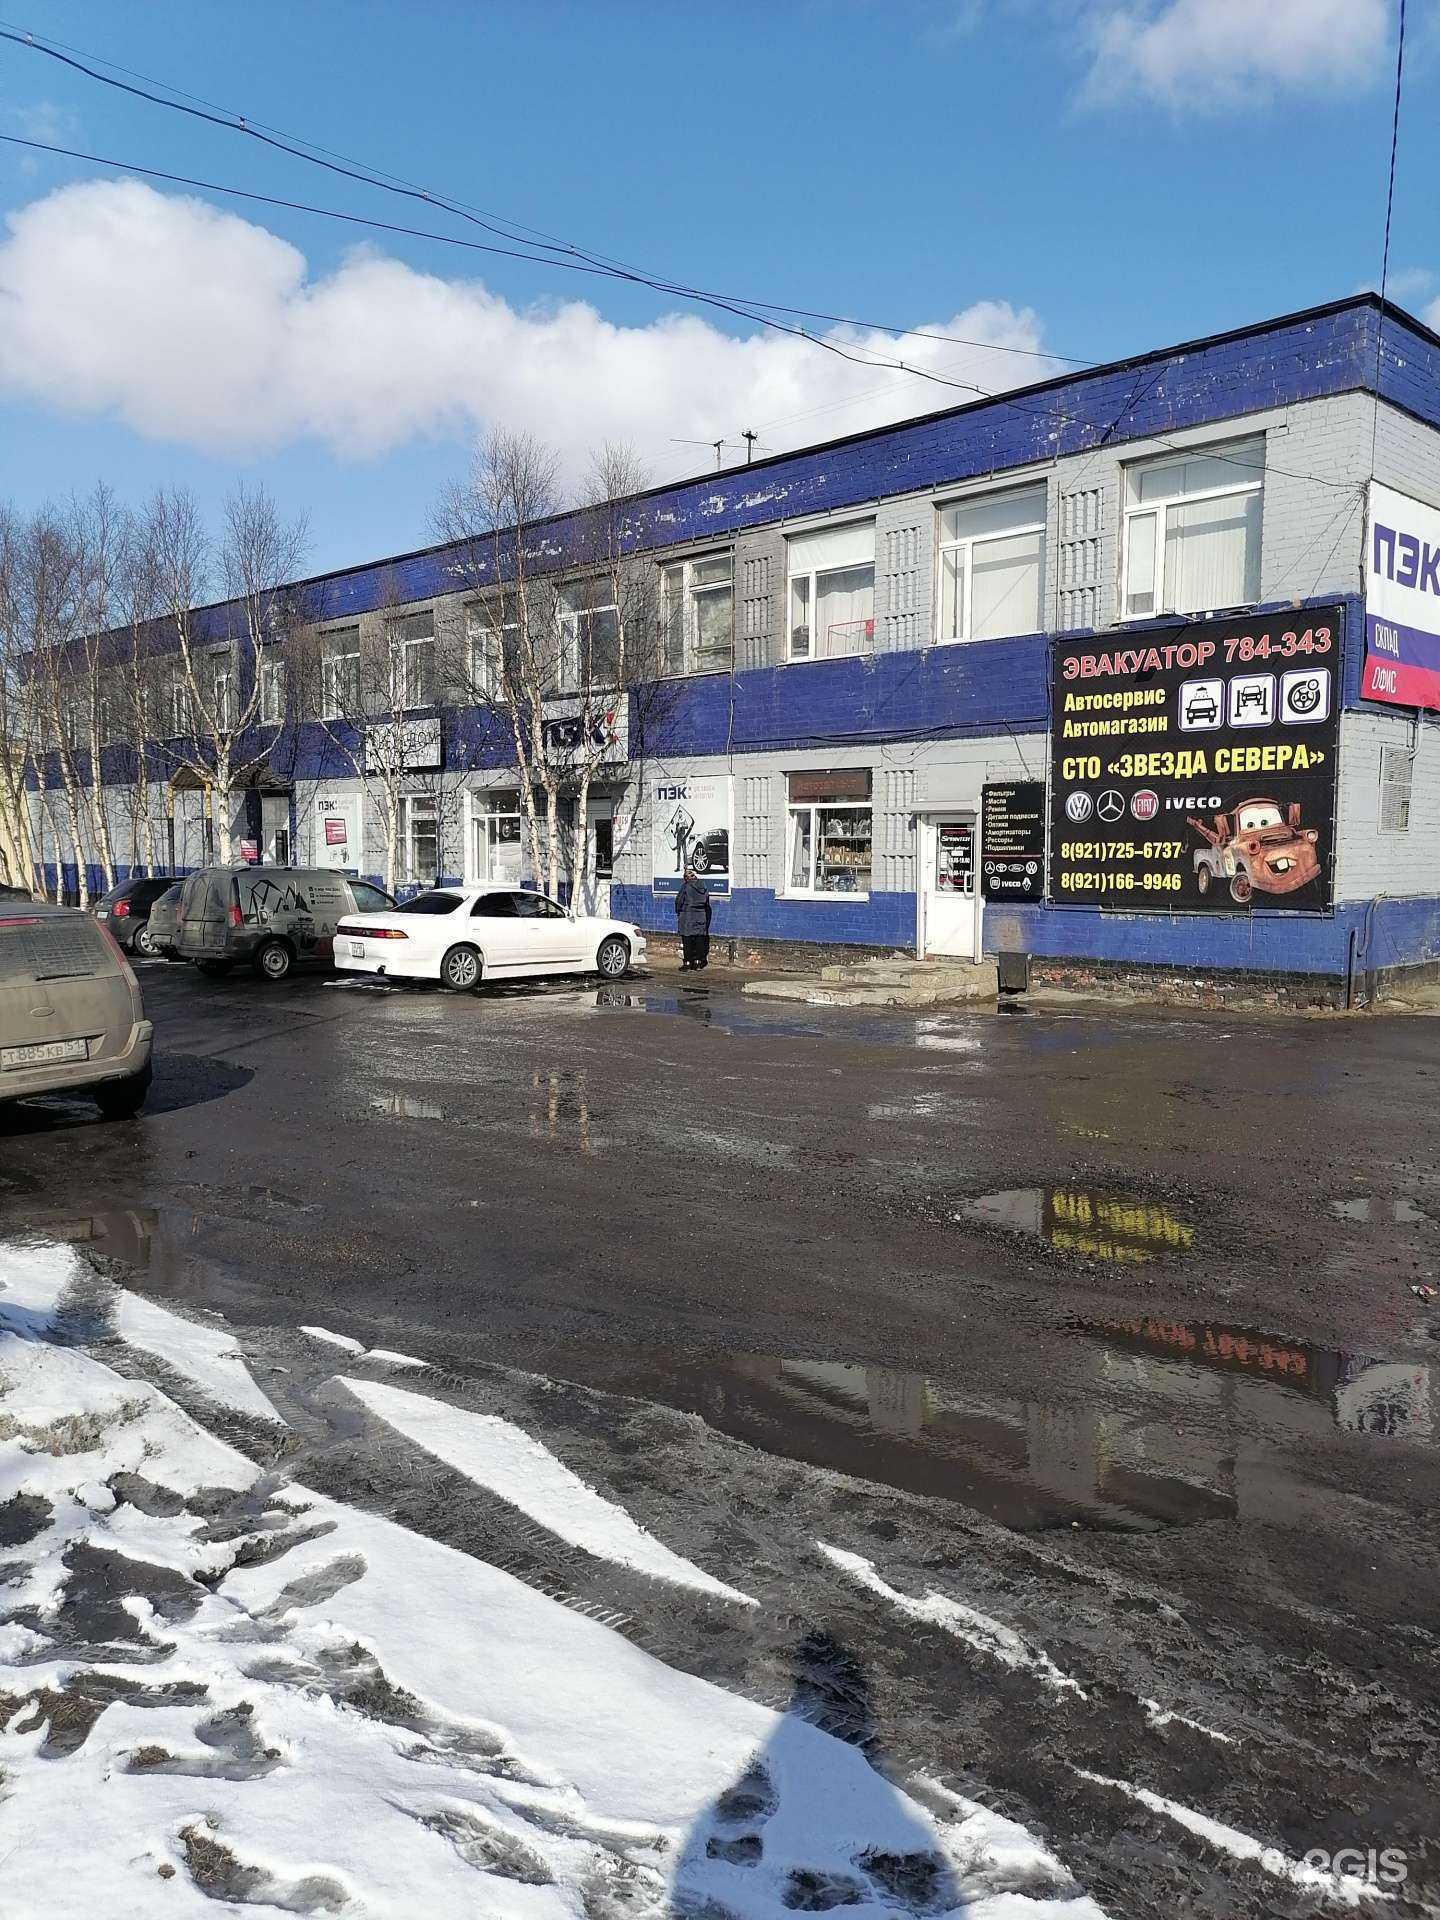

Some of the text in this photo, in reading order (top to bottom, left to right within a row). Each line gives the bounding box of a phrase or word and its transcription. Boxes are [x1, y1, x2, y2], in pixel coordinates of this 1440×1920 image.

[1373, 523, 1440, 596] ПЭК
[1375, 623, 1399, 658] СКЛАД
[1063, 627, 1332, 680] ЭВАКУАТОР 784-343
[1371, 666, 1397, 694] ОФИС
[1064, 688, 1166, 712] Автосервис
[1063, 714, 1168, 738] Автомагазин
[1062, 744, 1325, 780] СТО «ЗВЕЗДА СЕВЕРА»
[657, 787, 688, 800] ПЭК
[1165, 796, 1222, 810] IVECO
[318, 800, 335, 811] ПЭК
[1137, 798, 1153, 813] FIAT
[1061, 842, 1182, 862] 8(921)725-6737
[1001, 880, 1021, 888] IVECO
[1061, 872, 1182, 892] 8(921)166-9946
